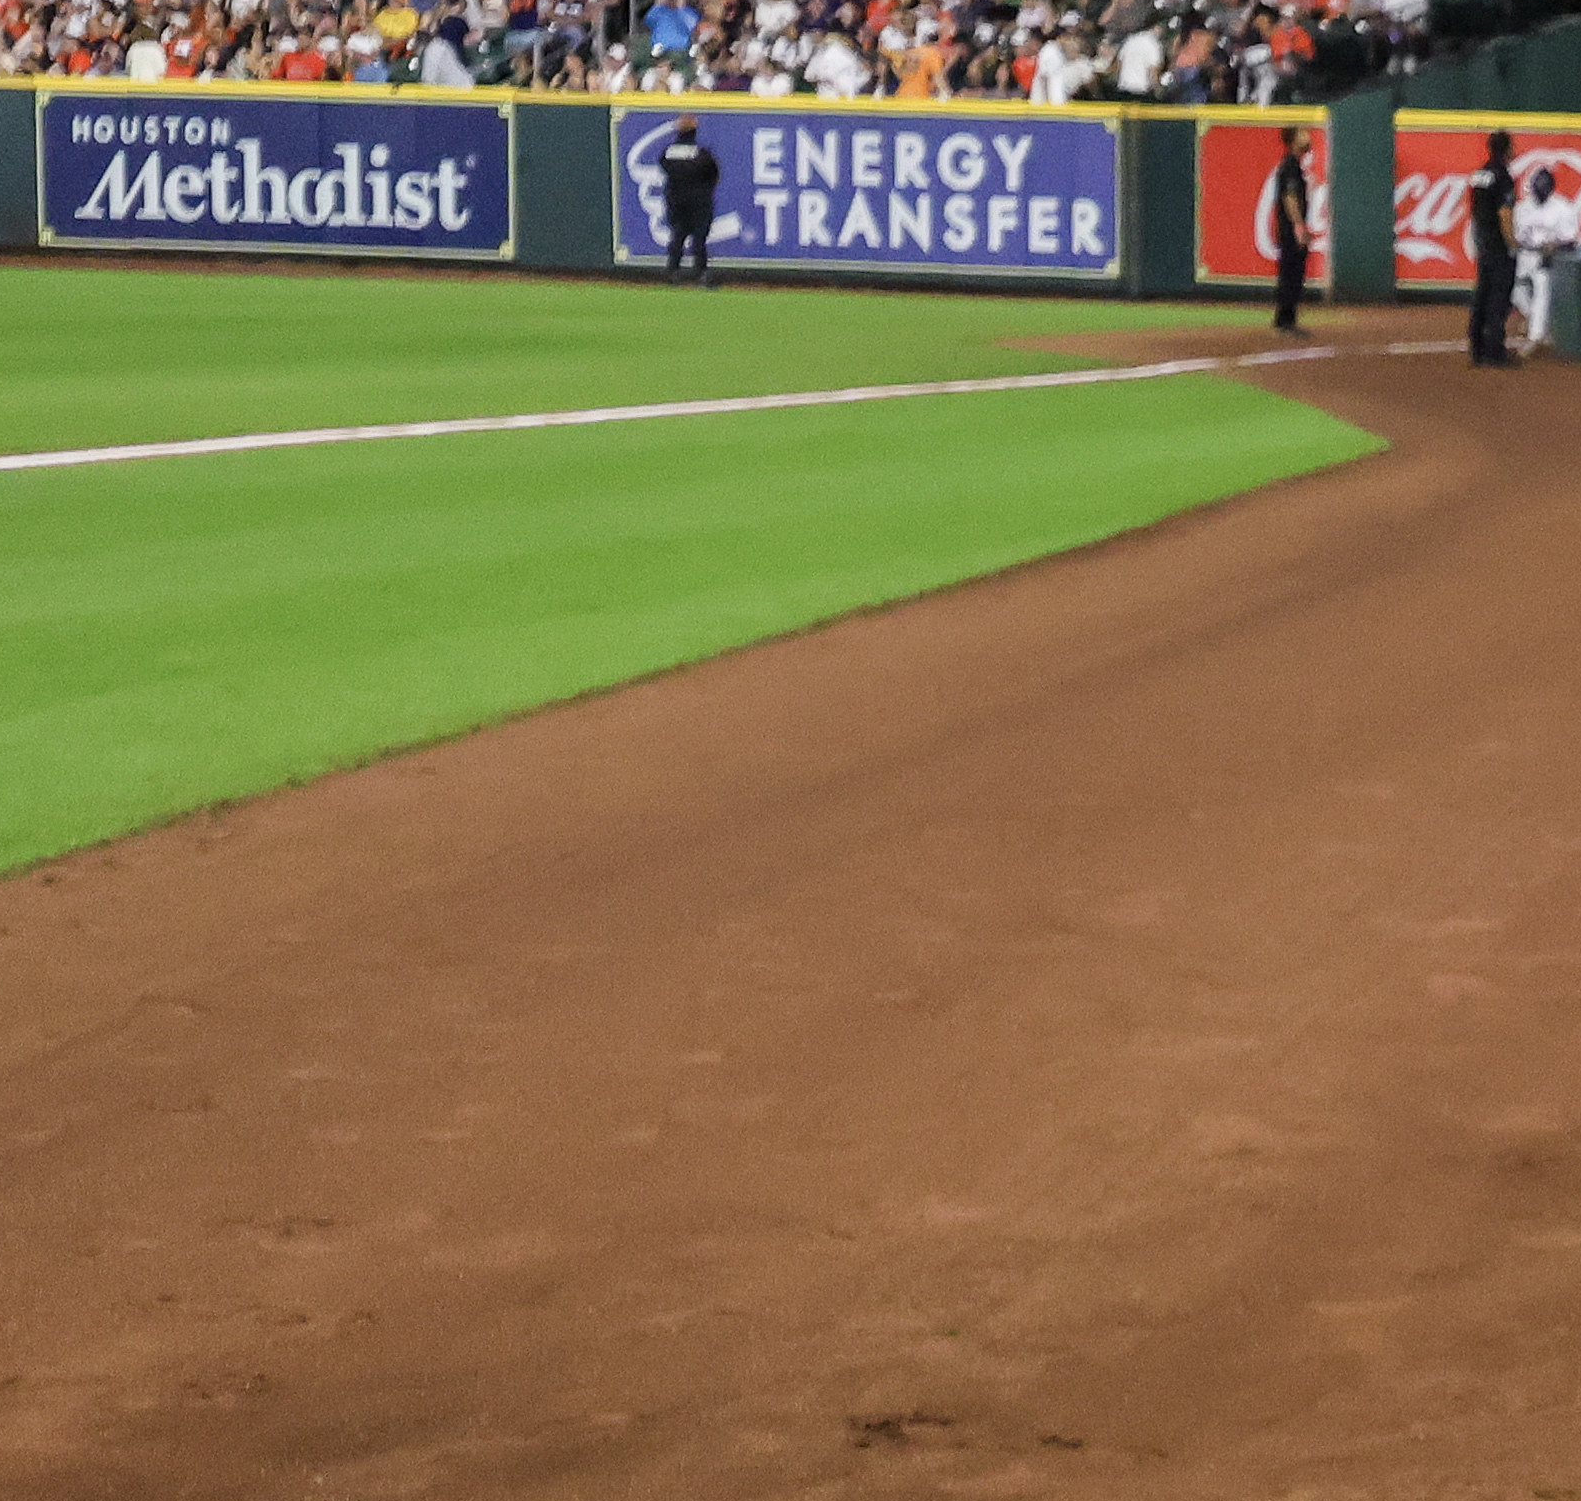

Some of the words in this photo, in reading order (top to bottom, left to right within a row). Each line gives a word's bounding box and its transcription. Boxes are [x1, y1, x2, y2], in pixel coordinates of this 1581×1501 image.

[71, 114, 231, 147] HOUSTON
[752, 127, 1033, 192] ENERGY
[74, 137, 473, 232] Methodist
[752, 188, 1106, 257] TRANSFER
